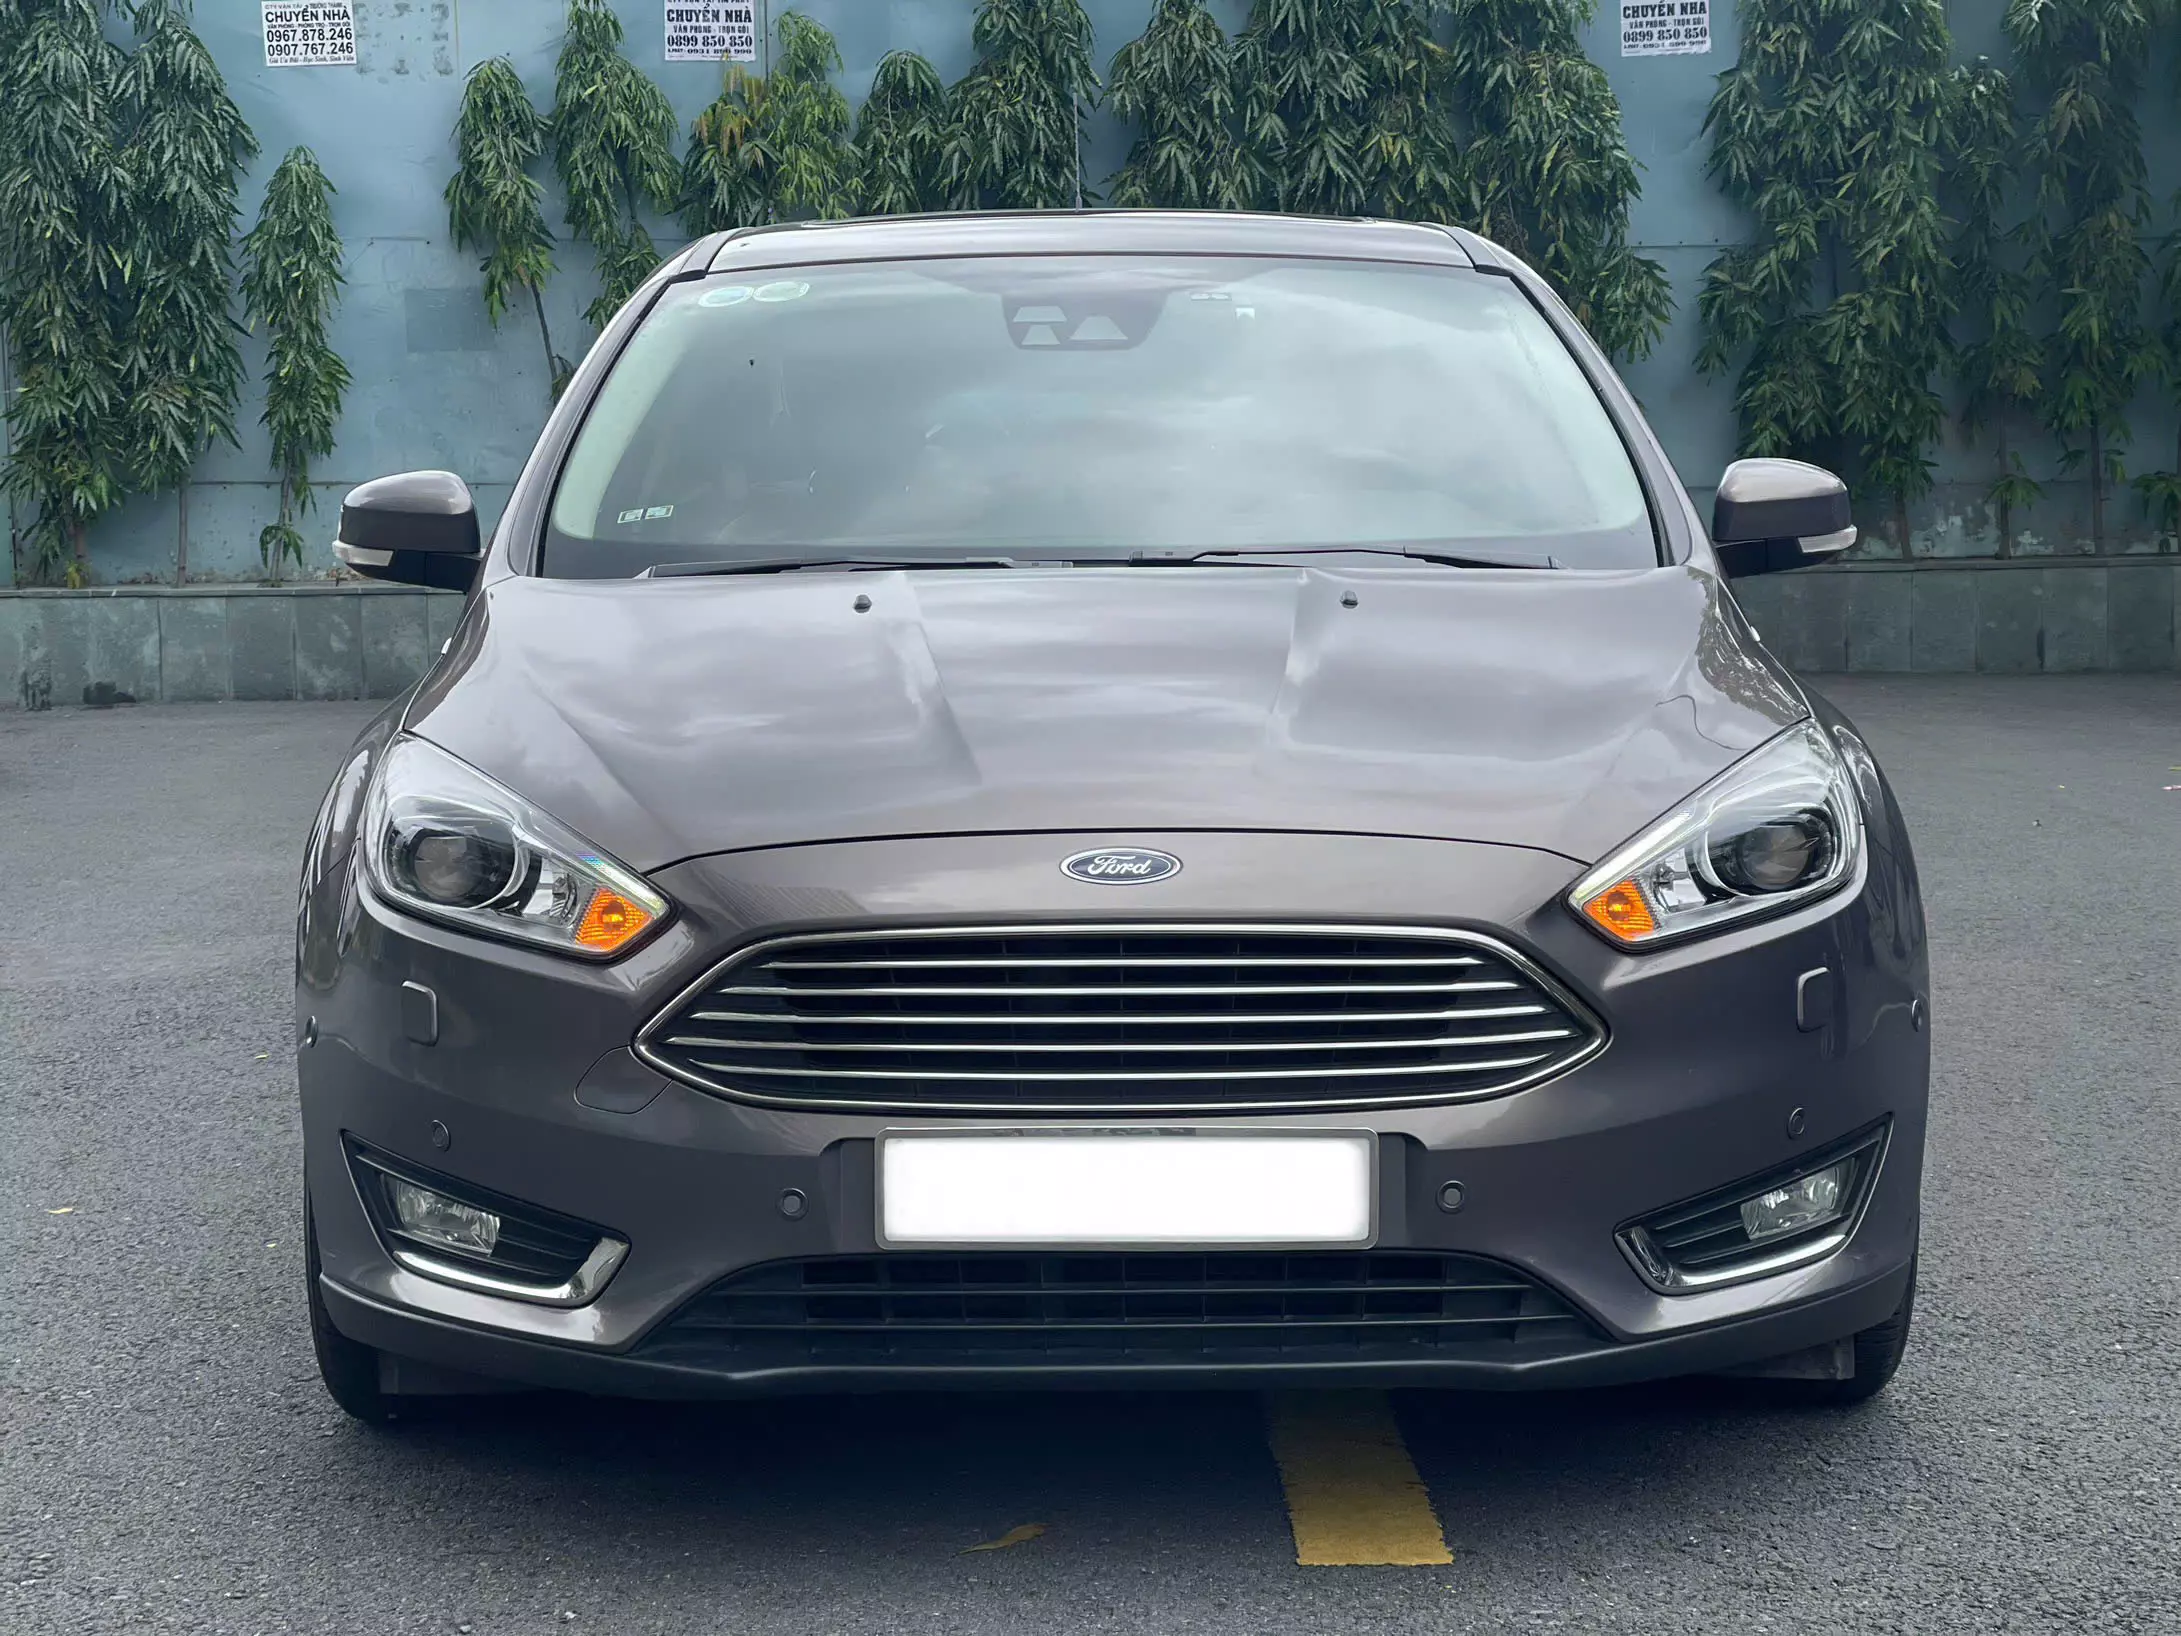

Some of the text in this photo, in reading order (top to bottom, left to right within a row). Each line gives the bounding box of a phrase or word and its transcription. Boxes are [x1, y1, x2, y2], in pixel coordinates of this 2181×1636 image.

[265, 5, 351, 22] CHUYỂN NHÀ
[667, 3, 752, 22] CHUYỂN NHÀ
[266, 28, 352, 42] 0967.878.246
[667, 35, 753, 47] 0899 850 850
[1623, 26, 1708, 43] 0899 850 850
[267, 42, 353, 56] 0907.767.246
[1087, 855, 1152, 875] Ford
